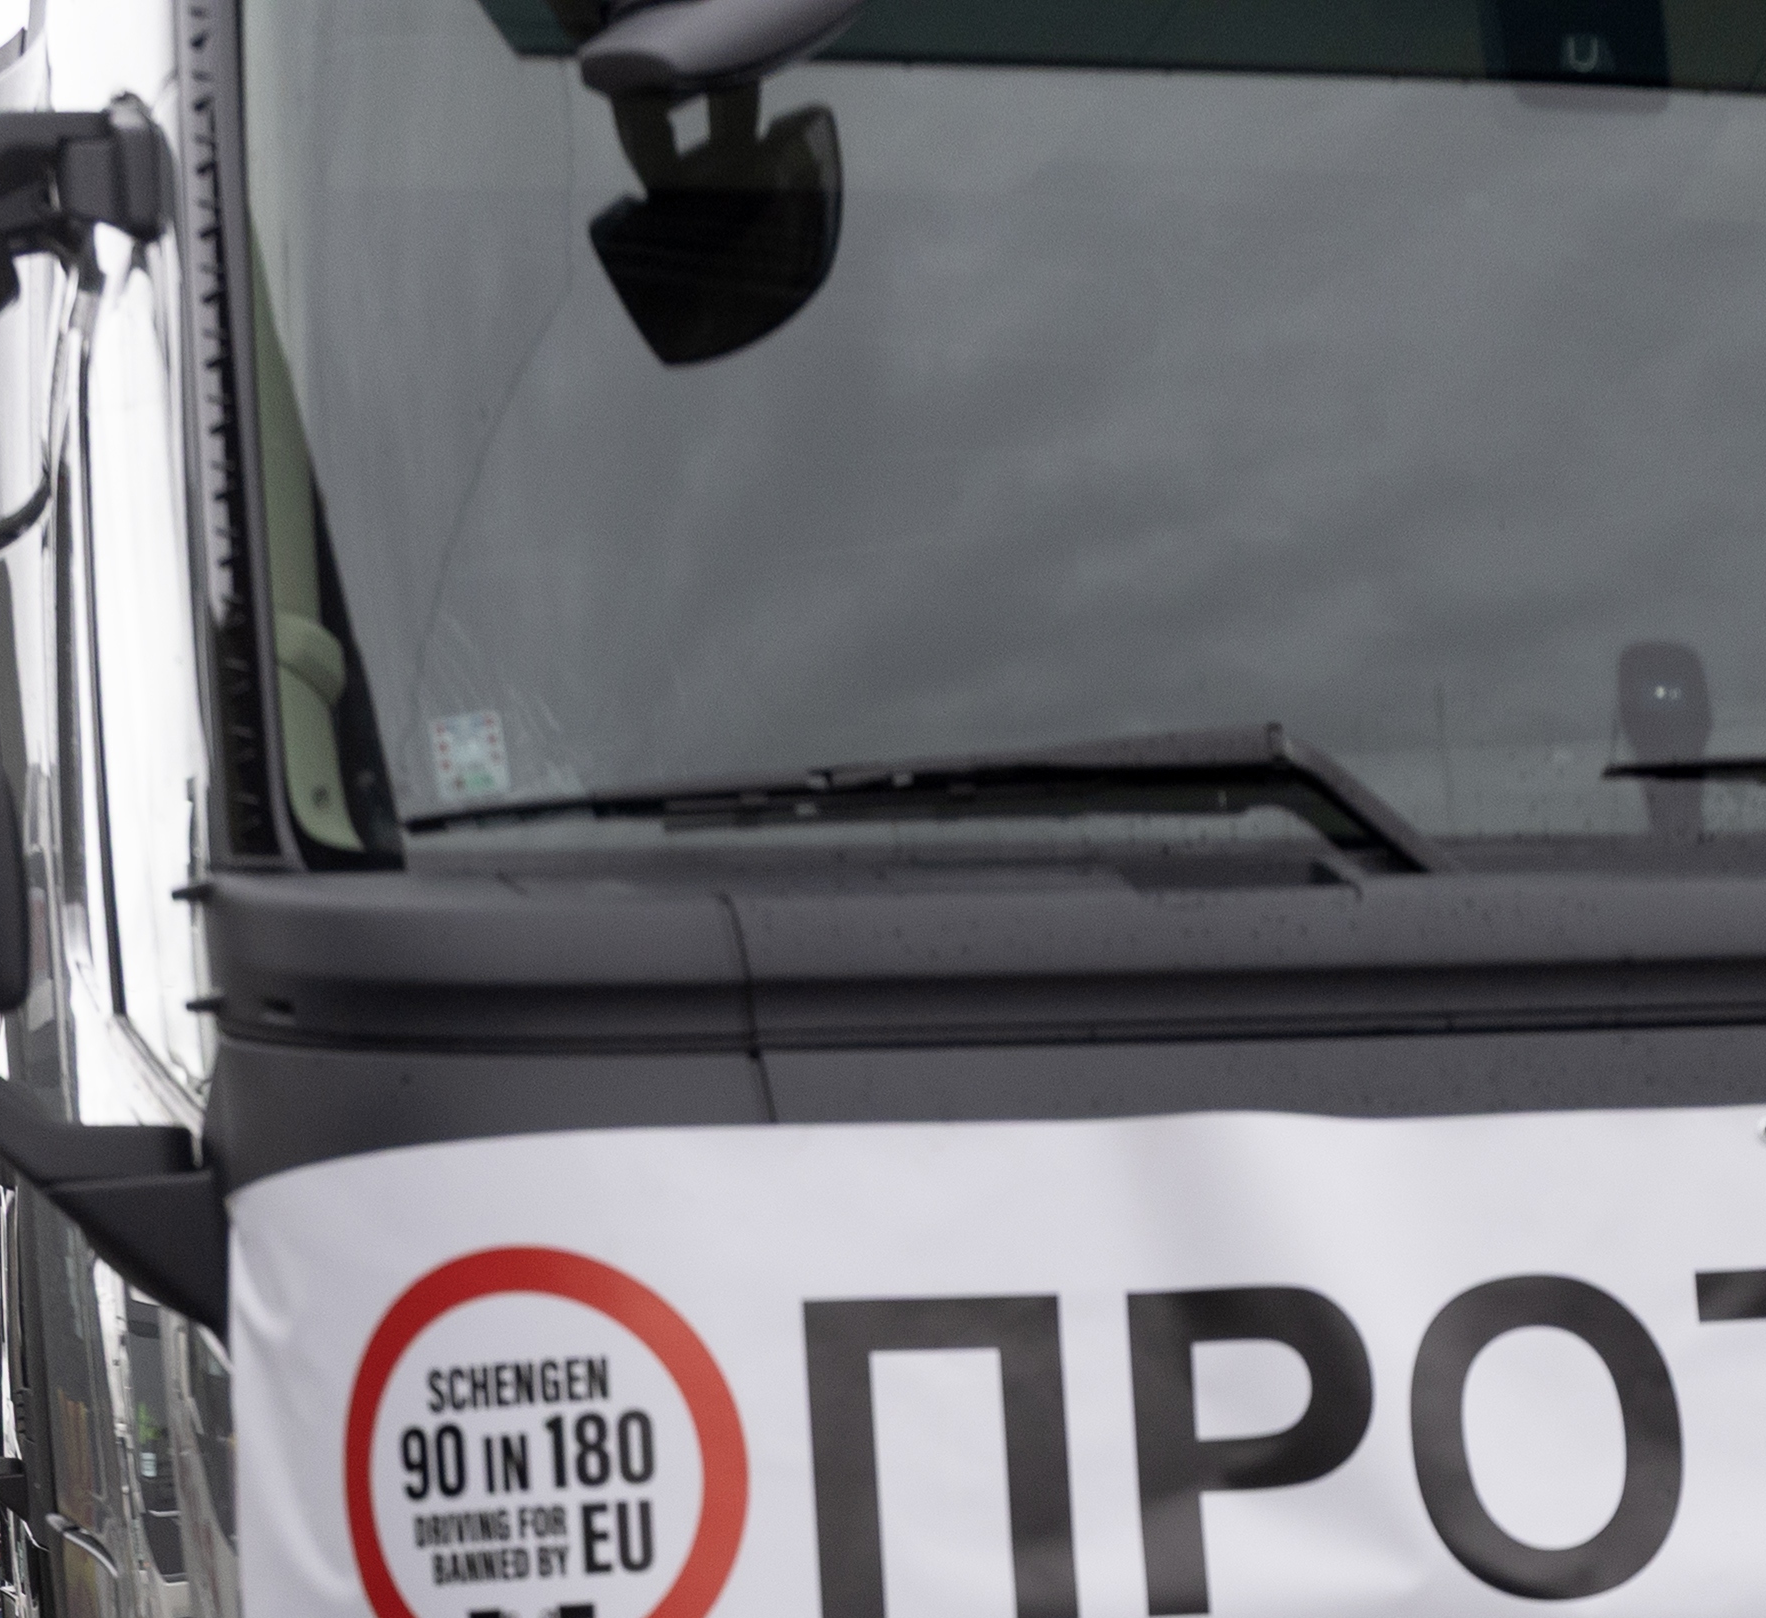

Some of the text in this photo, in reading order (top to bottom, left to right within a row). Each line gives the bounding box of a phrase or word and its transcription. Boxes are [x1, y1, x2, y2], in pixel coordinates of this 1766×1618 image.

[427, 1355, 609, 1414] SCHENGEN
[401, 1409, 655, 1500] 90 IN 180
[413, 1506, 568, 1548] DRIVING FOR
[581, 1500, 654, 1575] EU
[431, 1546, 571, 1586] BANNED BY
